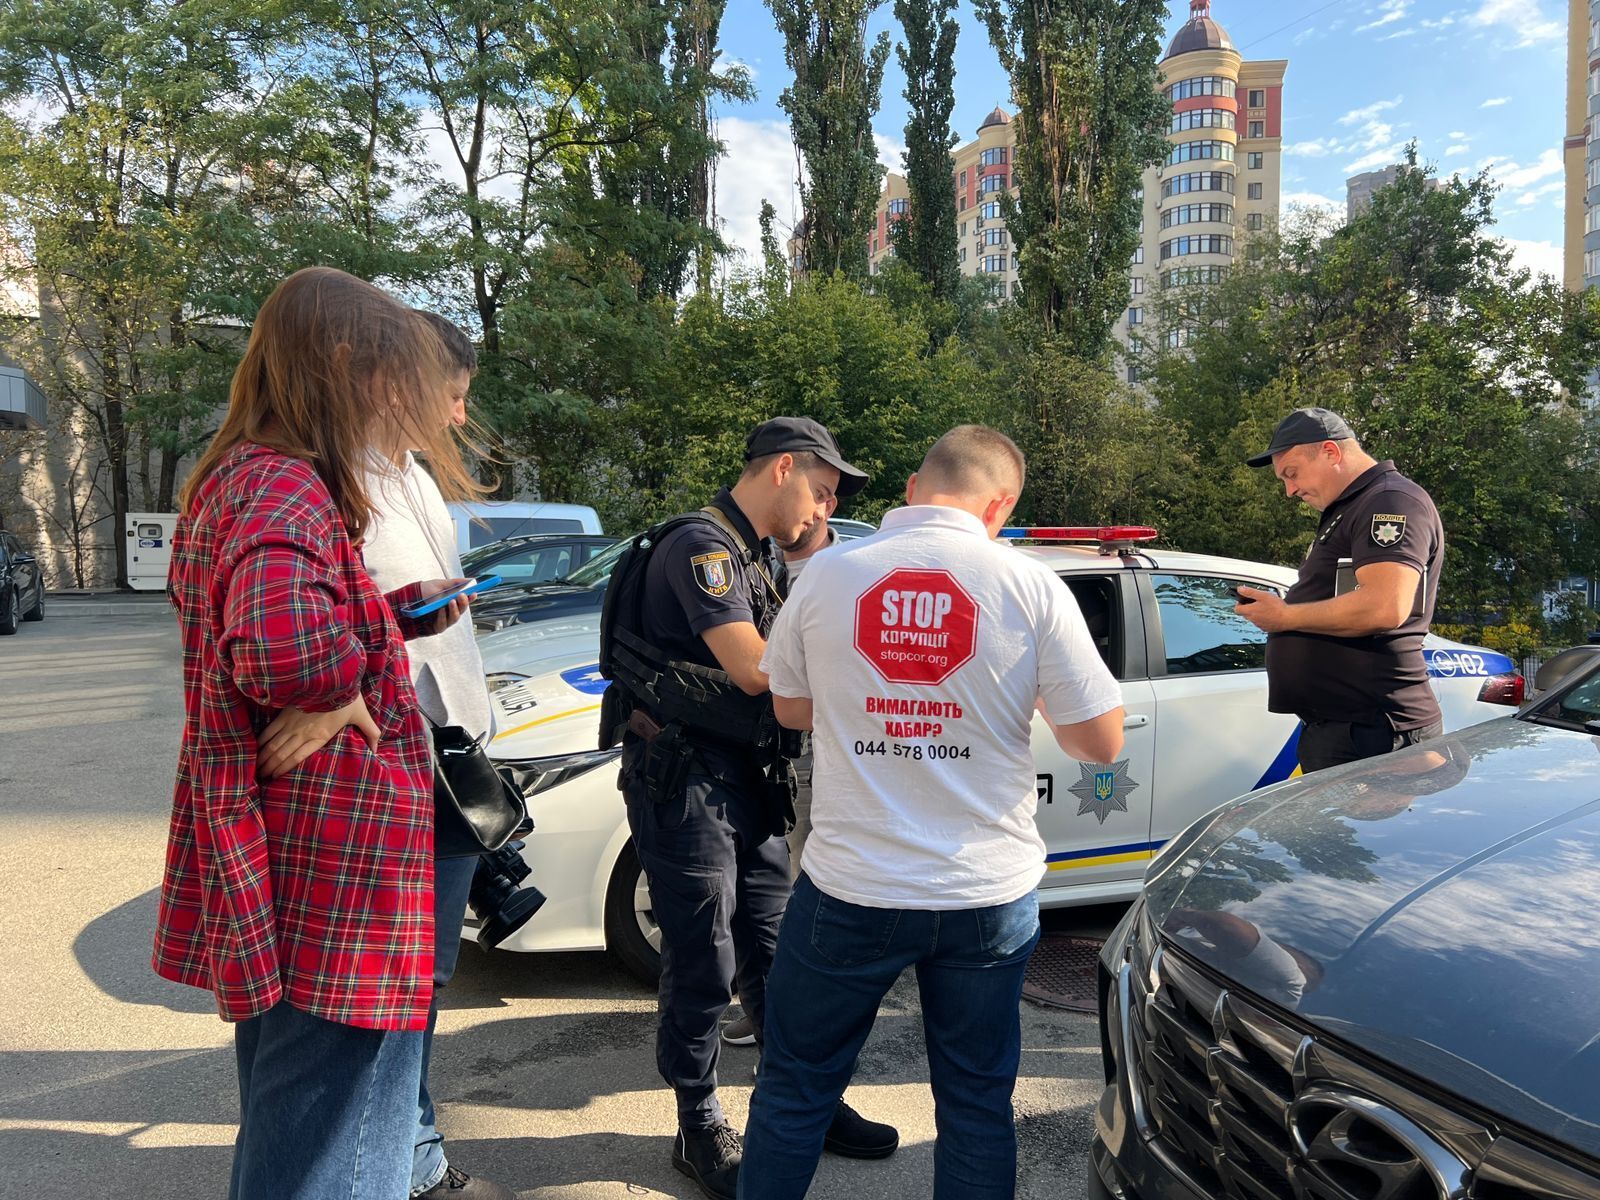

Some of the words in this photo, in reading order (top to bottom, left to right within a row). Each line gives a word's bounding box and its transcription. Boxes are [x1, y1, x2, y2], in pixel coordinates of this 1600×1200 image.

[881, 589, 952, 629] STOP
[880, 630, 950, 648] КОРУПЦІЇ
[880, 650, 948, 666] stopcor.org
[1453, 653, 1488, 675] 102
[865, 696, 963, 719] ВИМАГАЮТЬ
[885, 721, 943, 738] ХАБАР?
[854, 740, 887, 756] 044
[892, 743, 923, 760] 578
[928, 744, 971, 760] 0004
